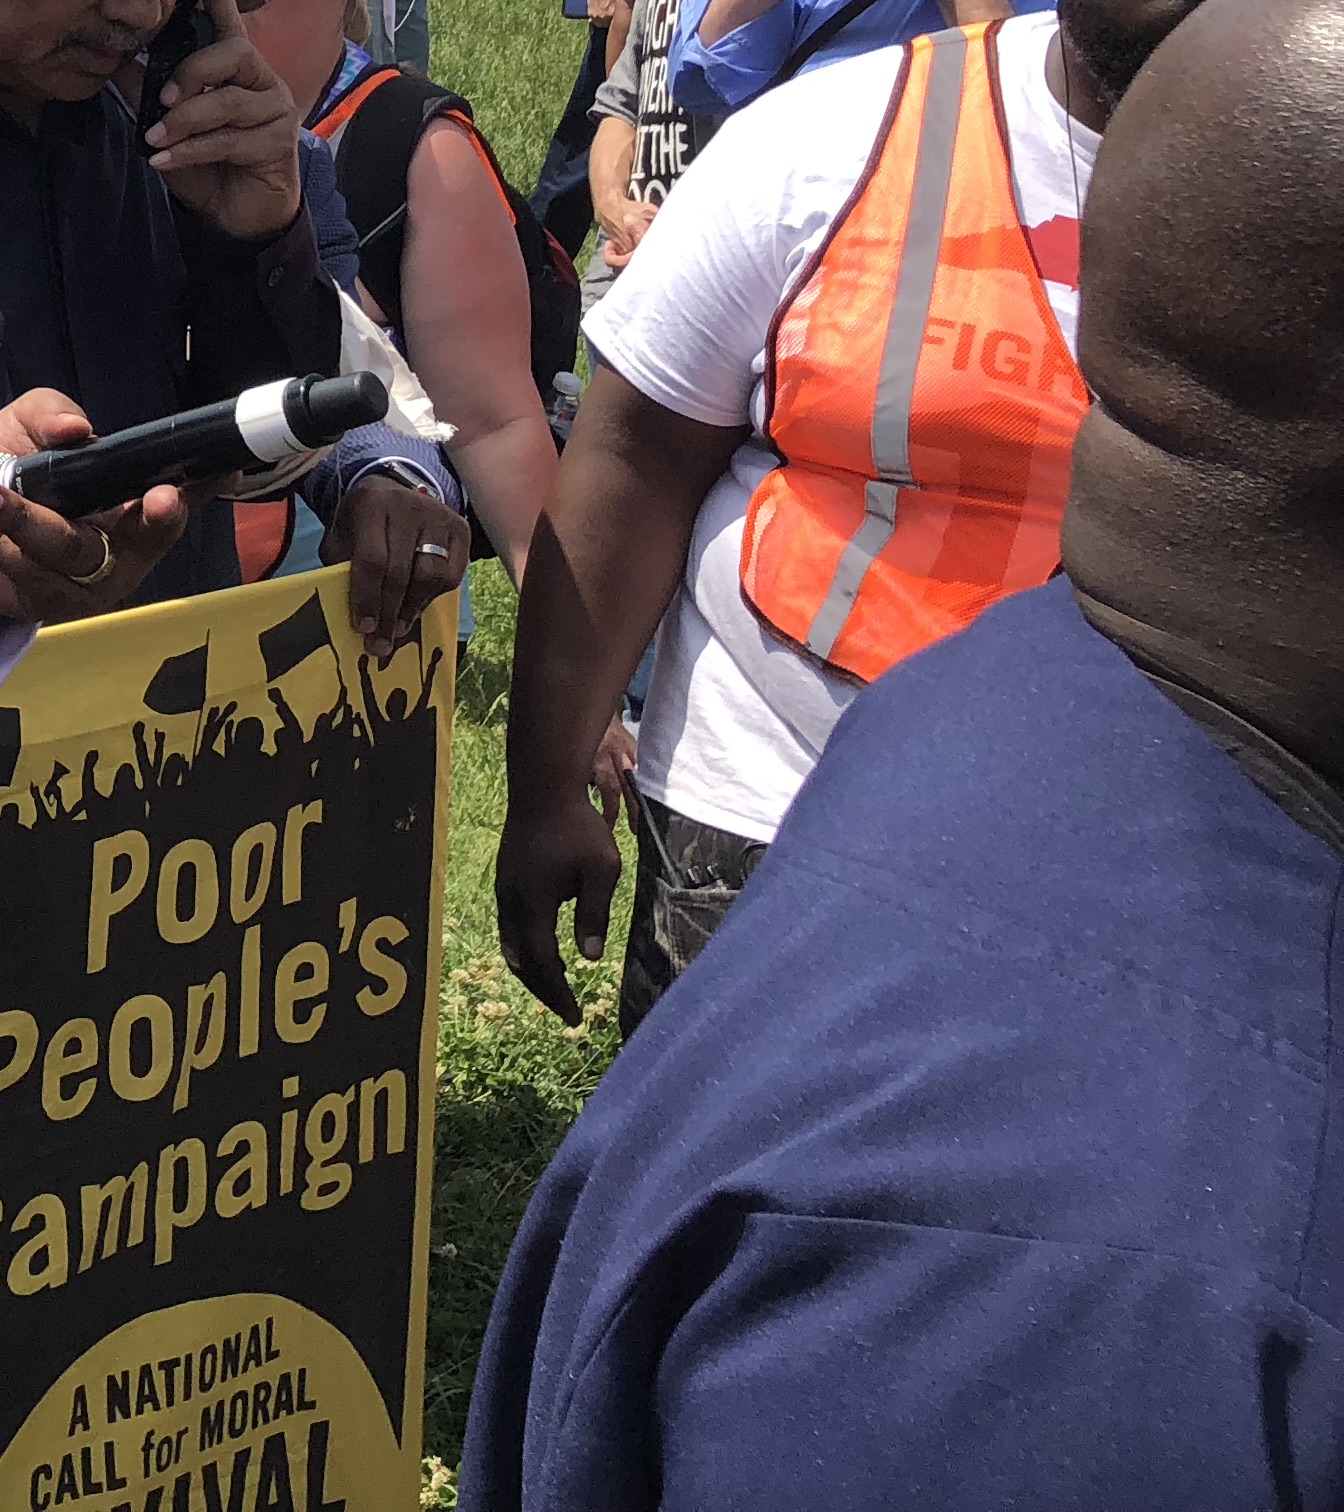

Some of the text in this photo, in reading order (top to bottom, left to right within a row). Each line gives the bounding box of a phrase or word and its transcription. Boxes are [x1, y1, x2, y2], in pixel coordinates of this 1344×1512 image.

[648, 122, 688, 176] THE
[87, 799, 322, 975] Poor
[30, 1368, 317, 1510] CALL for MORAL
[68, 1318, 280, 1437] A NATIONAL
